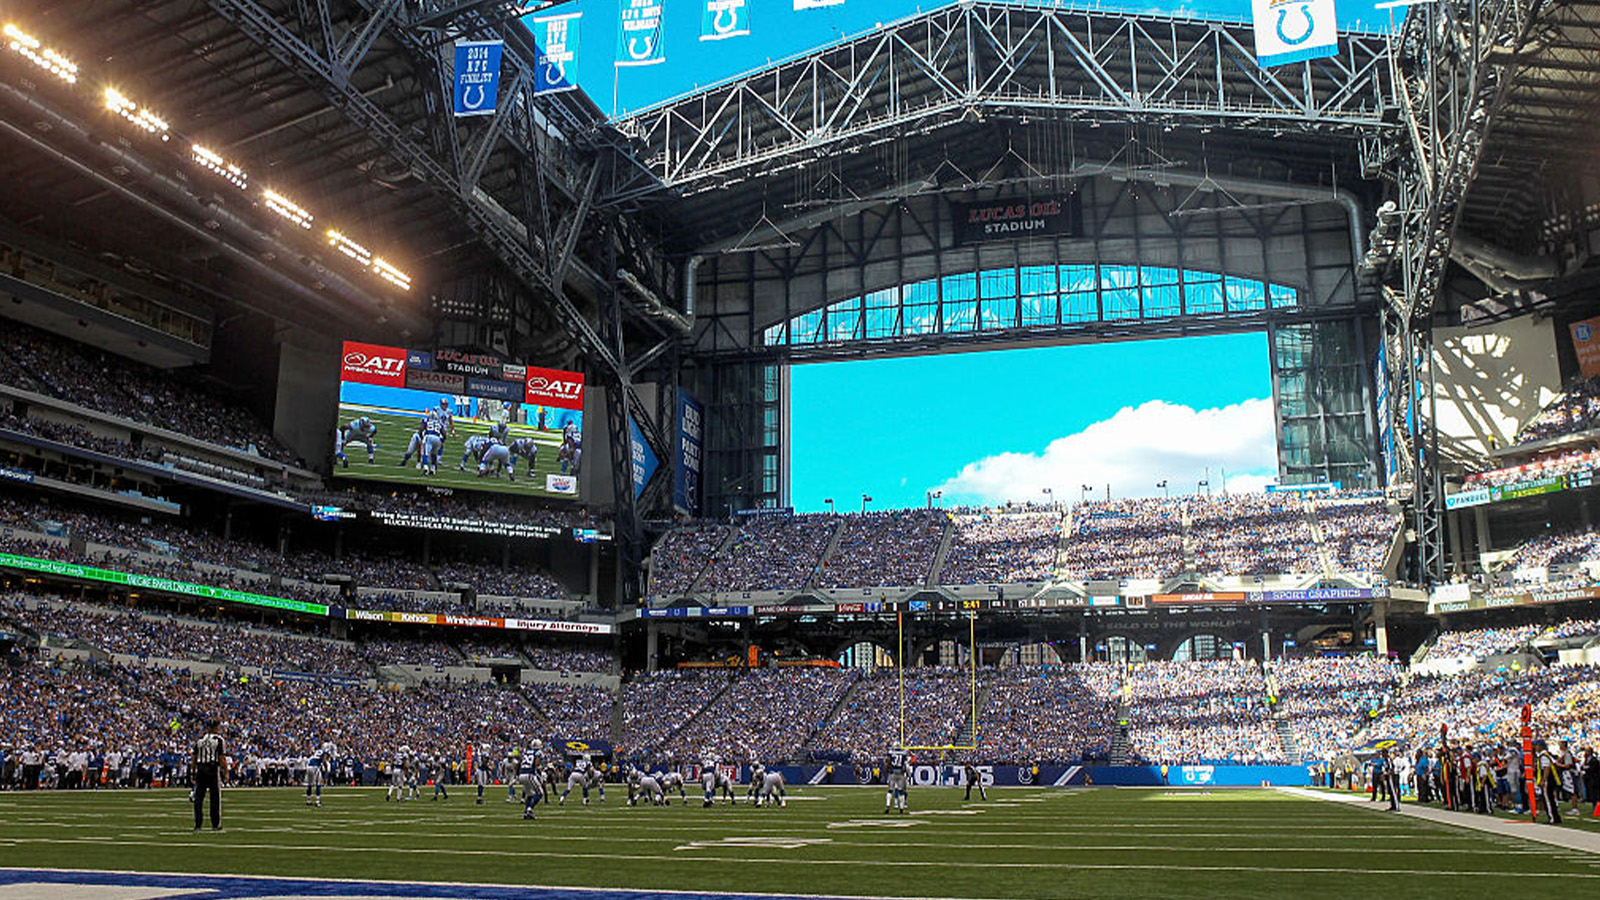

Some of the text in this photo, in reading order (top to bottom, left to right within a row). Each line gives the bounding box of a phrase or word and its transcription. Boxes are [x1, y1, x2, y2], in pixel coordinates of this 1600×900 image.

[467, 47, 489, 60] 2014
[460, 73, 493, 84] FINALIST
[969, 202, 1061, 222] LUCAS OIL
[985, 219, 1045, 233] STADIUM
[437, 350, 476, 364] LUCAS
[363, 356, 404, 371] ATI
[447, 362, 488, 375] STADIUM
[408, 370, 463, 385] SHARP
[487, 385, 507, 393] LIGHT
[546, 381, 582, 394] ATI
[40, 562, 51, 571] and
[52, 564, 66, 573] legal
[1273, 588, 1361, 600] SPORT GRAPHICS
[1532, 589, 1586, 602] Winingham
[1440, 602, 1468, 612] Wilson
[1486, 597, 1514, 607] Kehoe
[355, 610, 384, 620] Wilson
[401, 614, 429, 622] Kehoe
[445, 615, 489, 627] Winingham
[550, 621, 599, 633] Attorneys
[891, 754, 903, 766] 31
[905, 766, 994, 786] OLTS
